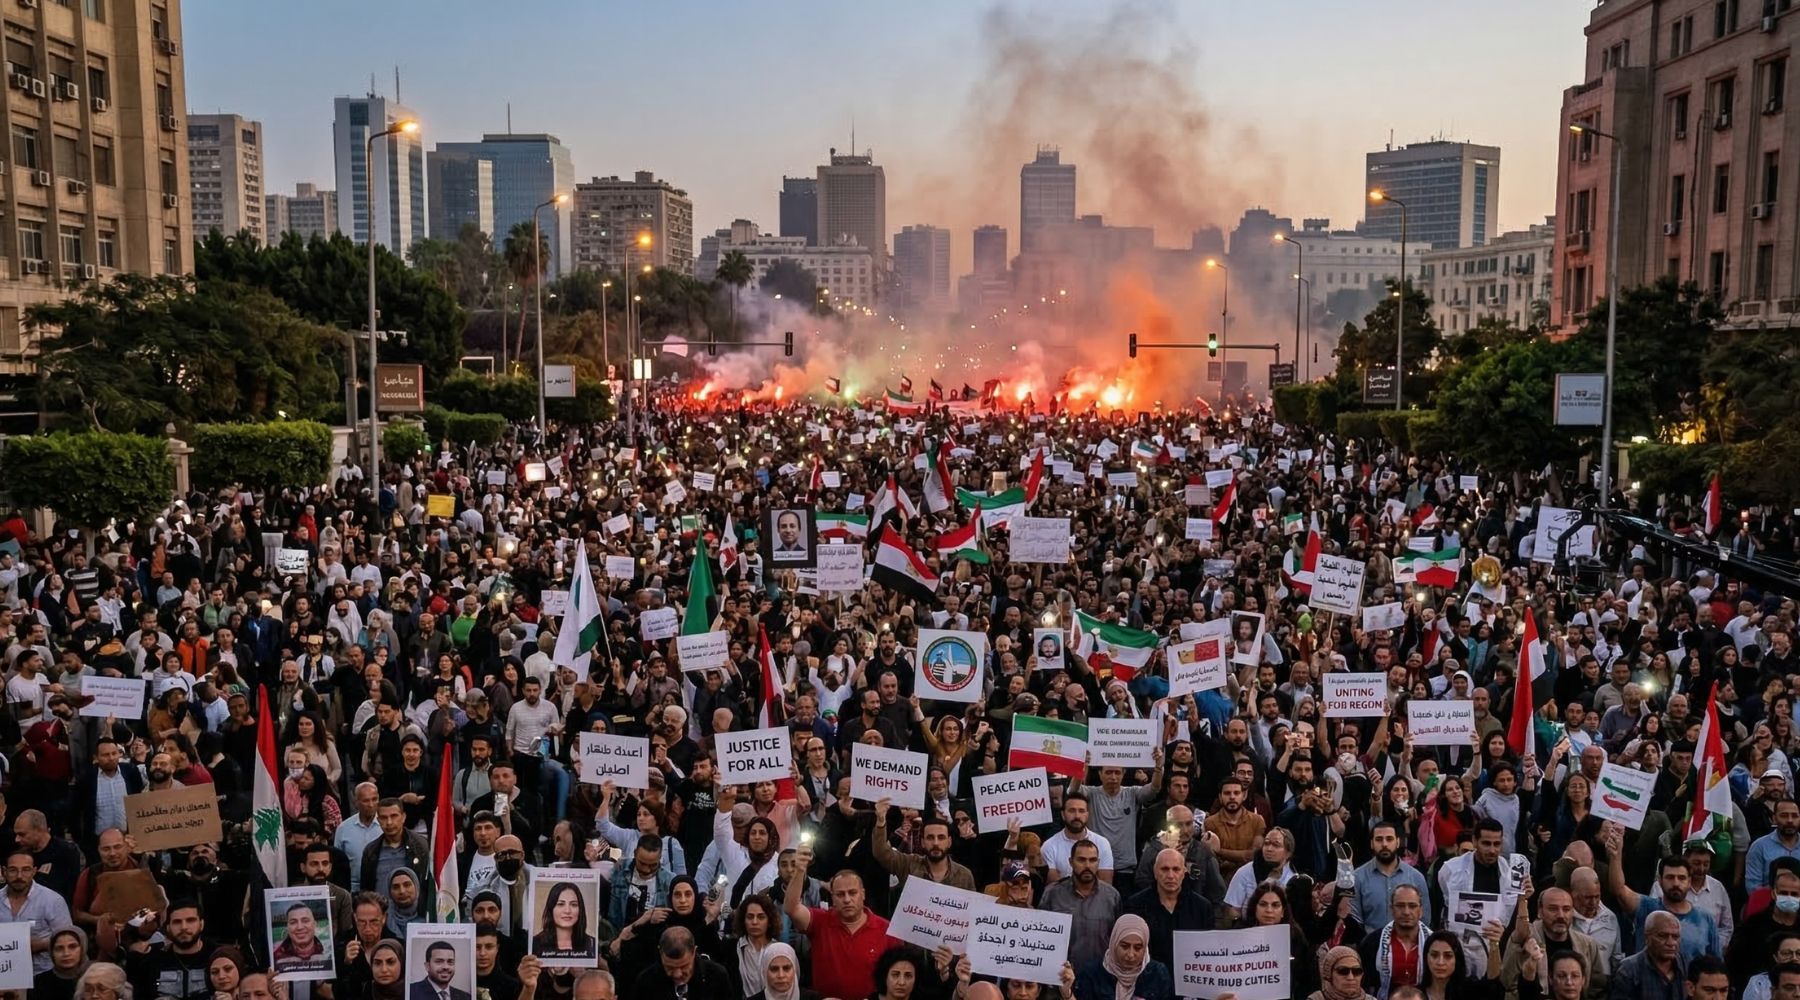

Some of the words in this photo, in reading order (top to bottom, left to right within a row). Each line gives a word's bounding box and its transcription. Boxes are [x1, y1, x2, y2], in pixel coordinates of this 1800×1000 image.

[1335, 688, 1374, 697] UNITING
[1349, 700, 1382, 709] REGON
[726, 738, 780, 754] JUSTICE
[728, 758, 757, 772] FOR
[758, 756, 784, 769] ALL
[855, 757, 873, 769] WE
[873, 760, 922, 775] DEMAND
[865, 775, 909, 791] RIGHTS
[980, 781, 1016, 796] PEACE
[1018, 777, 1042, 790] AND
[983, 797, 1046, 818] FREEDOM
[1184, 963, 1212, 972] DEVE
